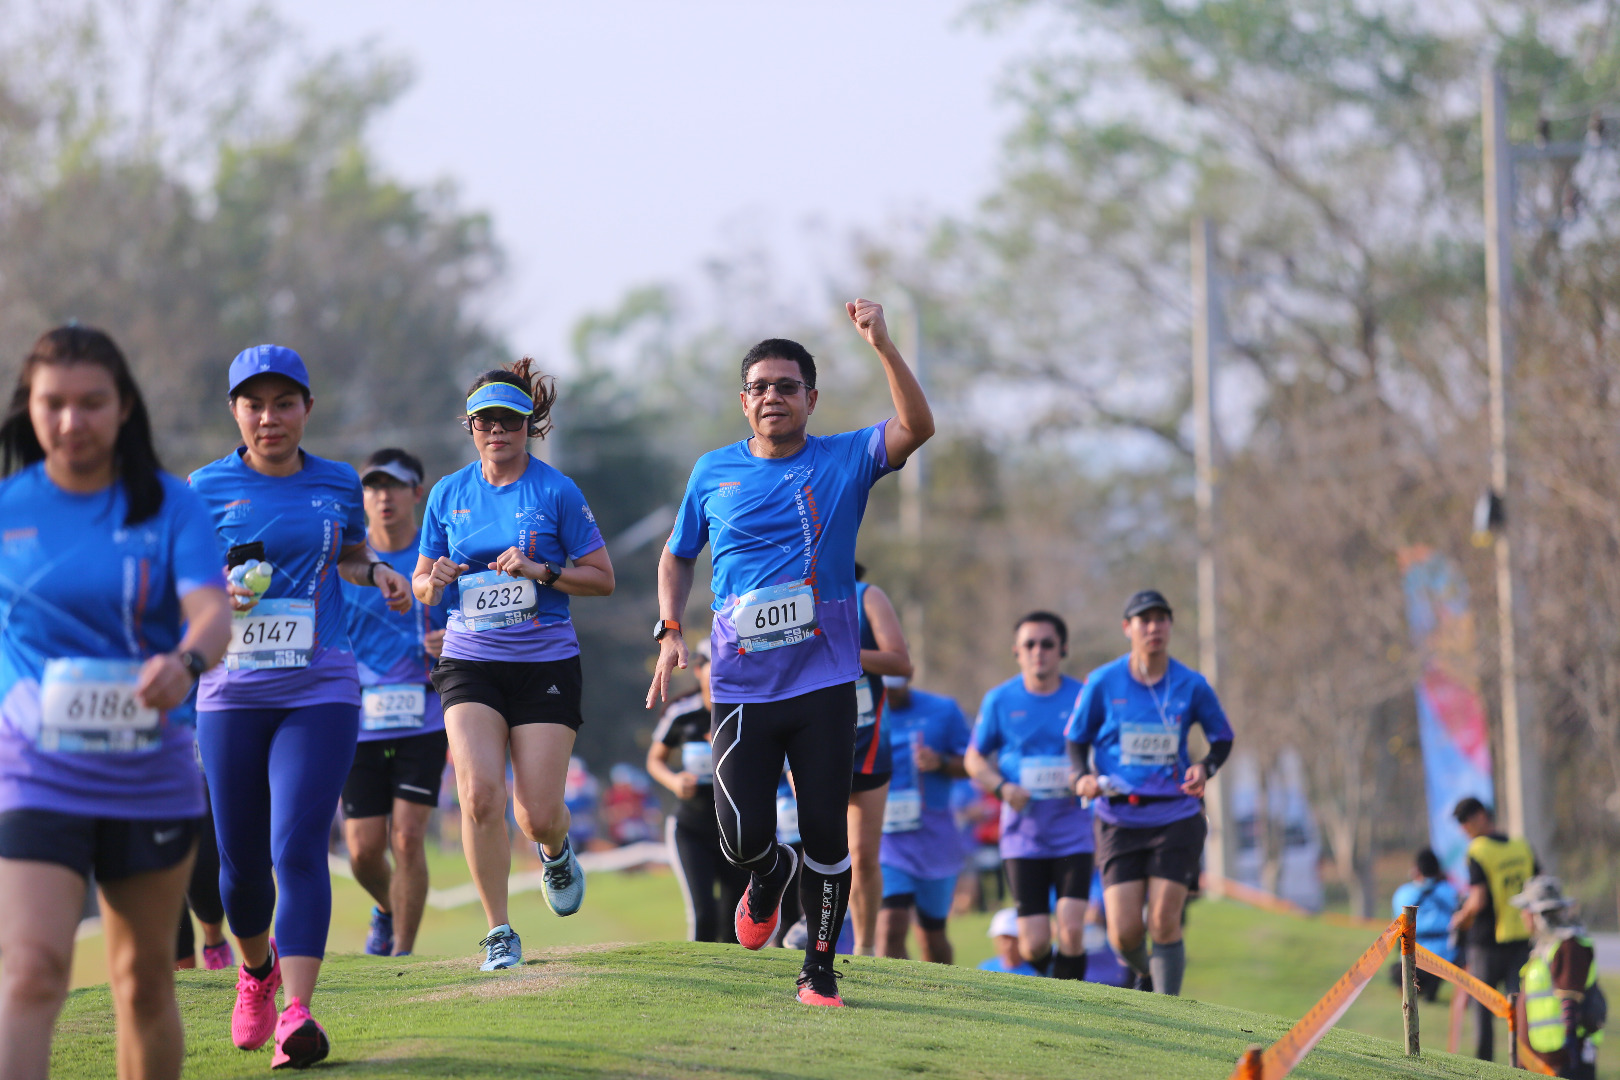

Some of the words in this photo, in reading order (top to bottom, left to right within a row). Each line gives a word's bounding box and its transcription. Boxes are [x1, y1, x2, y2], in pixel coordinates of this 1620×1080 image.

[803, 485, 819, 522] SINGHA
[322, 519, 331, 552] CROSS
[528, 530, 538, 559] SINGH
[476, 585, 523, 610] 6232
[755, 601, 797, 629] 6011
[243, 621, 298, 645] 6147
[67, 688, 138, 721] 6186
[376, 694, 416, 712] 6220
